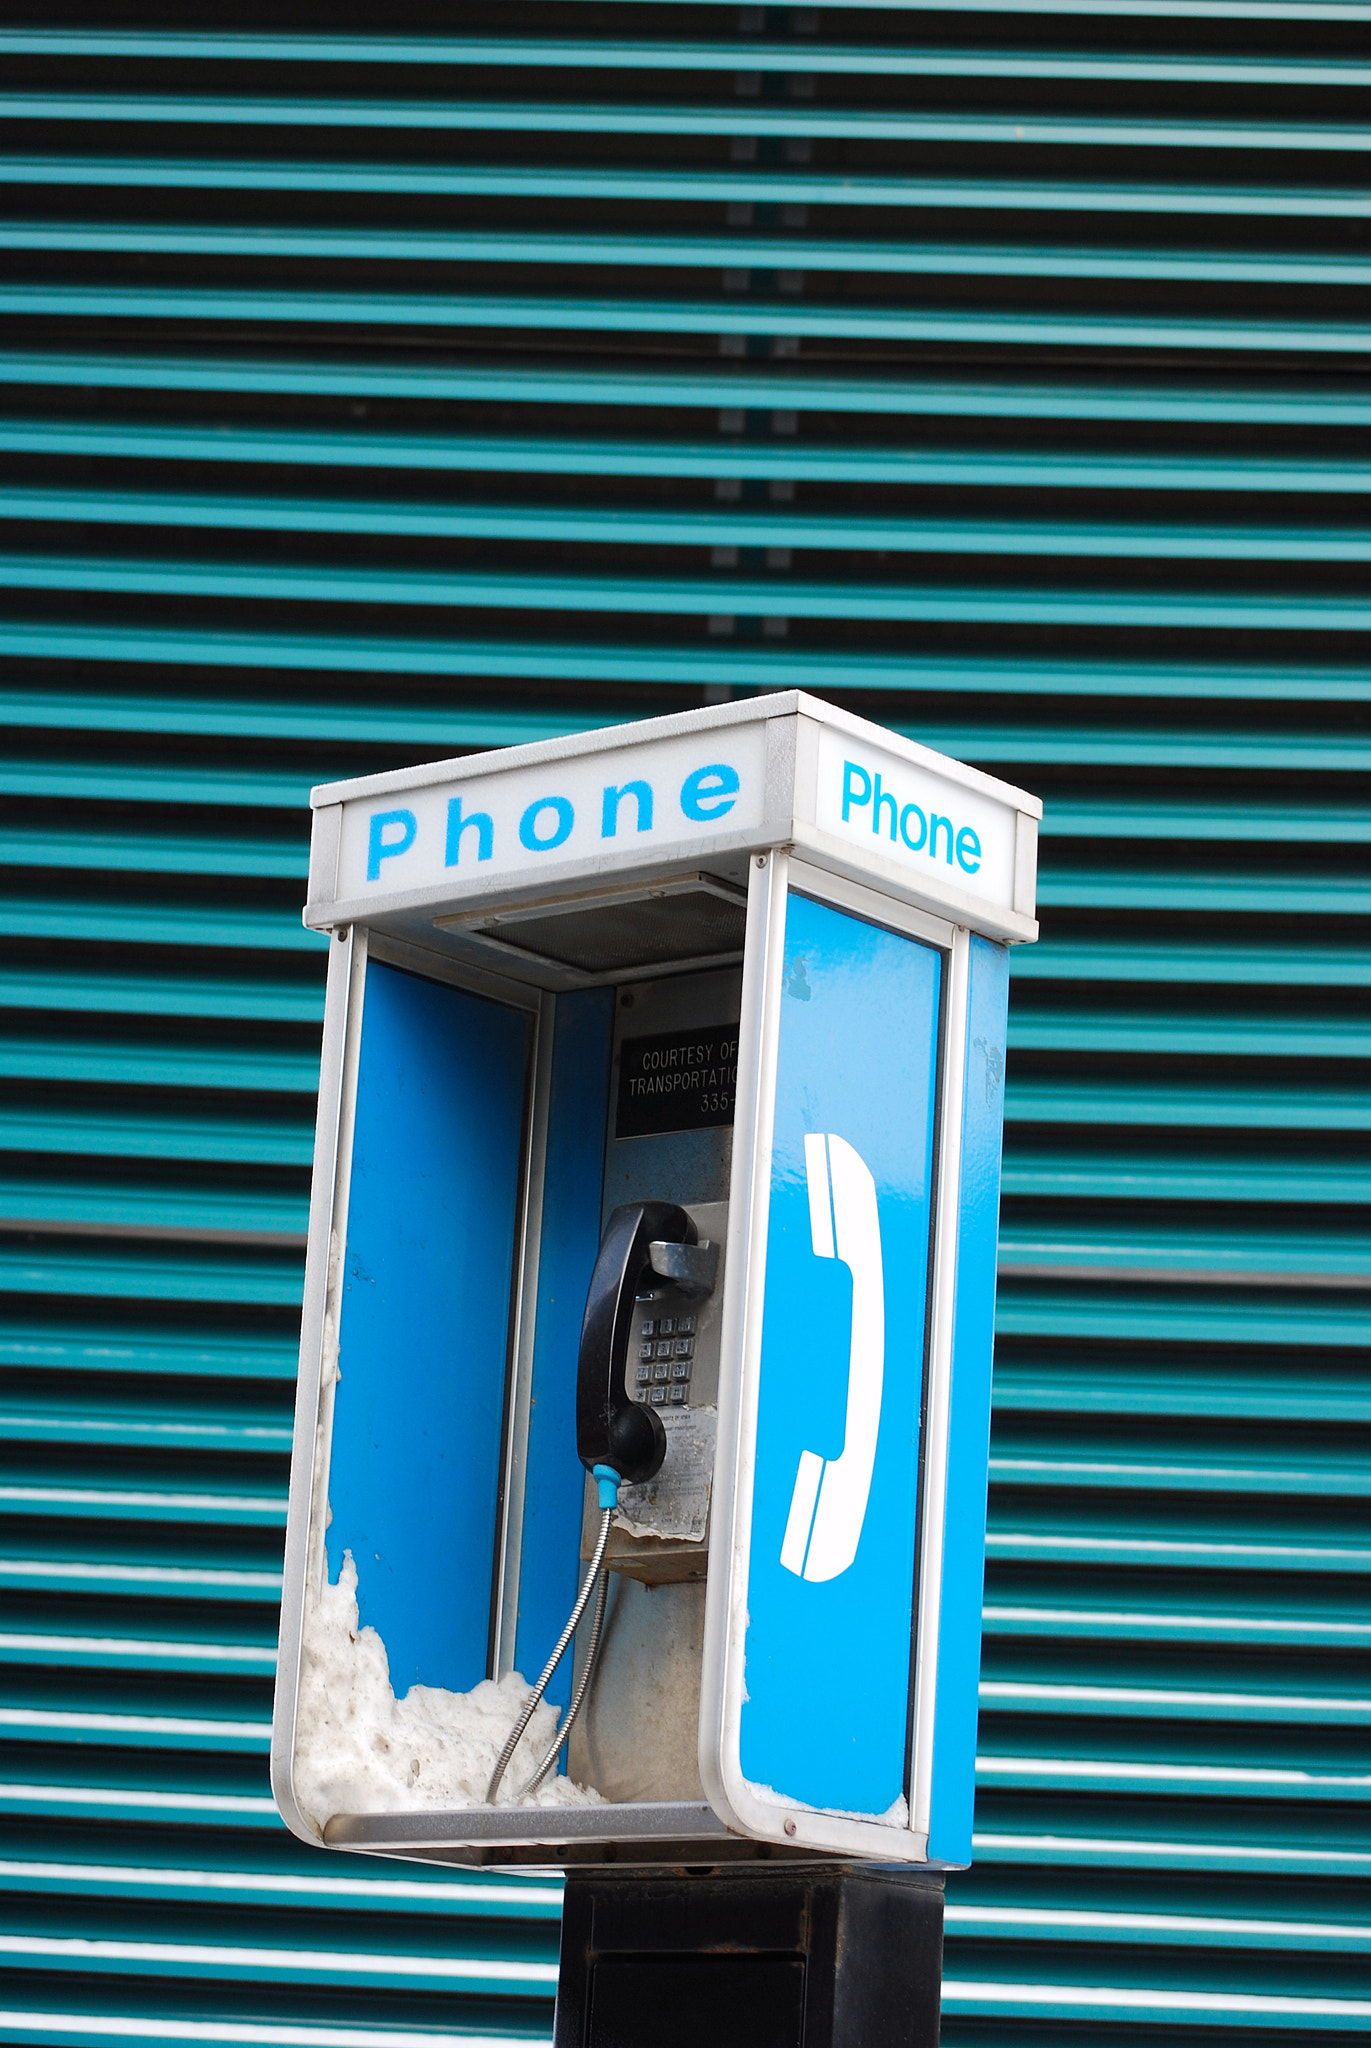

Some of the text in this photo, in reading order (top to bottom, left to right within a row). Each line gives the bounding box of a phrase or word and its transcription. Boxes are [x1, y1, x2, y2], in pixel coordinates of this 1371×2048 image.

[367, 764, 740, 881] Phone
[842, 760, 981, 874] Phone
[643, 1041, 738, 1070] COURTESY OF
